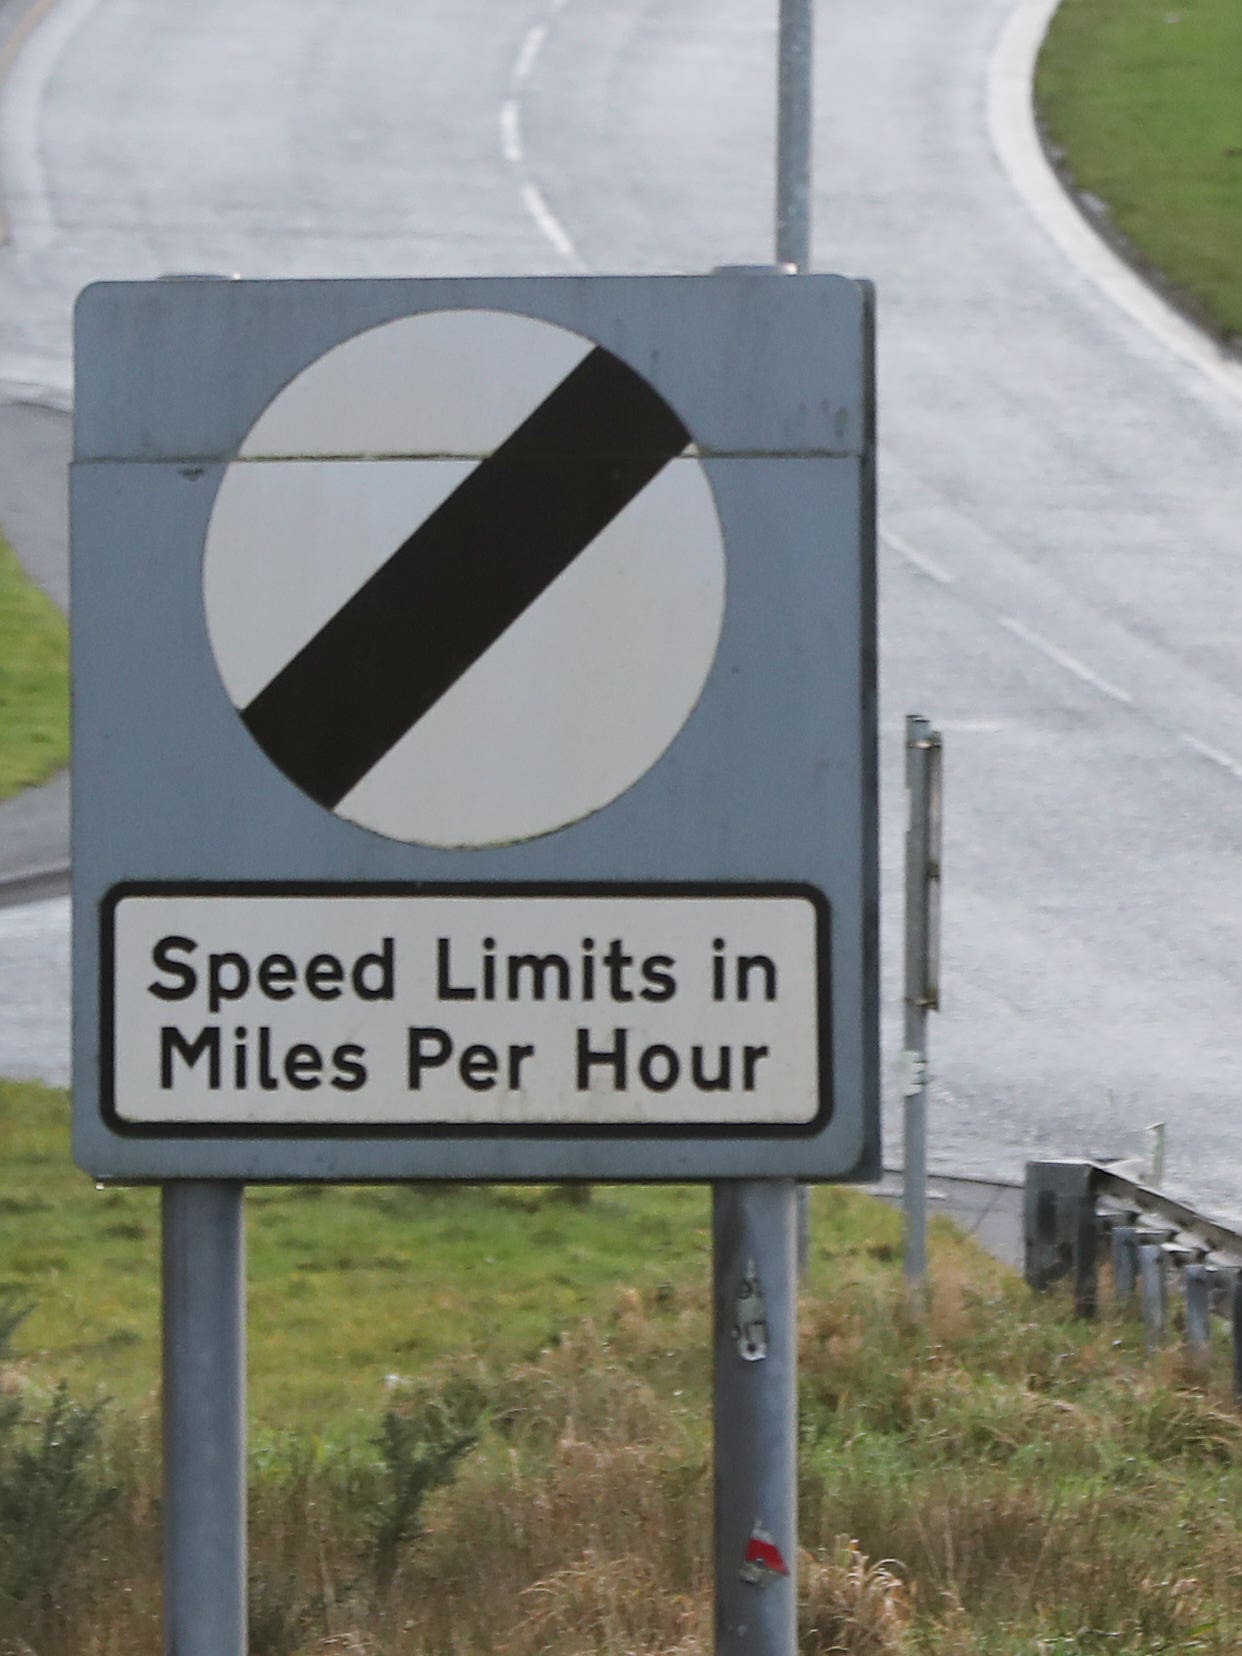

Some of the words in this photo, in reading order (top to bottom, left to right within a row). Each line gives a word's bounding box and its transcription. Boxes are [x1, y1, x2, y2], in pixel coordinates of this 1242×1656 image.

[148, 936, 395, 1013] Speed
[438, 936, 677, 1002] Limits
[713, 937, 777, 1002] in
[161, 1025, 368, 1091] Miles
[408, 1026, 535, 1091] Per
[576, 1027, 769, 1092] Hour
